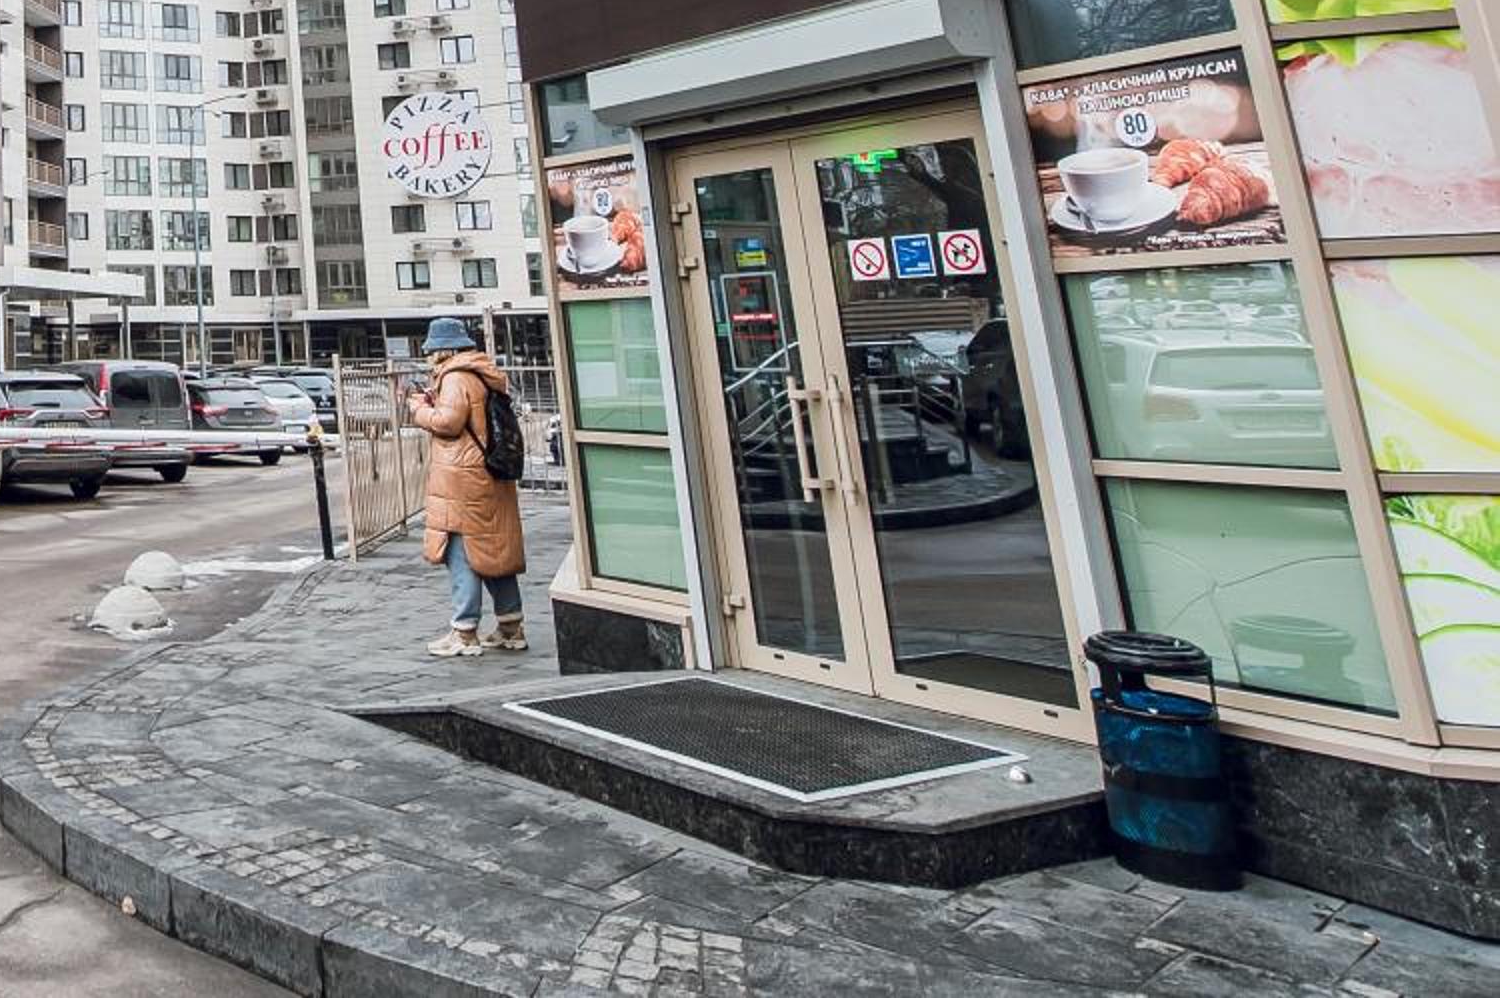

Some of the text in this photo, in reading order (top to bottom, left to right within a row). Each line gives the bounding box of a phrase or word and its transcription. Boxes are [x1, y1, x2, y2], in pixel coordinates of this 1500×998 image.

[1083, 69, 1168, 97] КЛАСИЧНИЙ
[1168, 59, 1237, 84] КРУАСАН
[1147, 85, 1190, 103] ЛИШЕ
[389, 96, 471, 130] PIZZA
[1123, 112, 1148, 134] 80
[394, 156, 482, 194] BAKERY
